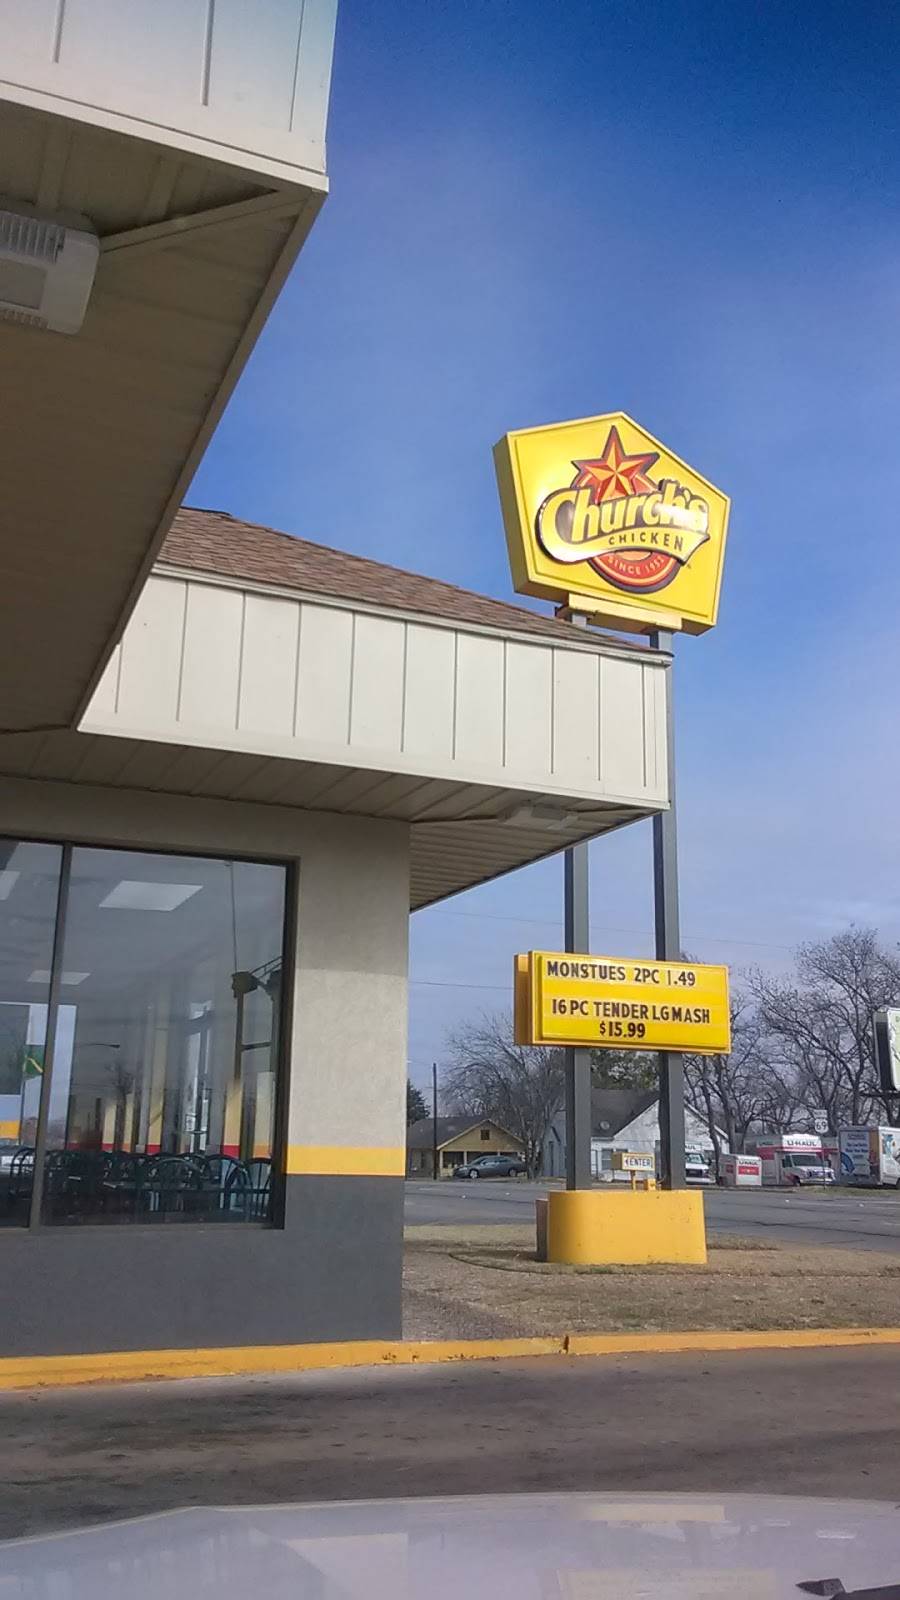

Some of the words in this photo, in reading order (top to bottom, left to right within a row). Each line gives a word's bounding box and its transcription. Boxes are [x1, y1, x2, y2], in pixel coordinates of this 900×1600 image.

[536, 479, 709, 562] Church's
[608, 532, 684, 551] CHICKEN
[607, 555, 641, 575] SINCE
[547, 961, 626, 981] MONSTUES
[634, 967, 660, 984] 2PC
[667, 970, 696, 987] 1.49
[552, 998, 567, 1014] 16
[570, 1000, 589, 1016] PC
[593, 1001, 648, 1020] TENDER
[599, 1021, 646, 1038] $15.99
[629, 1158, 651, 1167] ENTER
